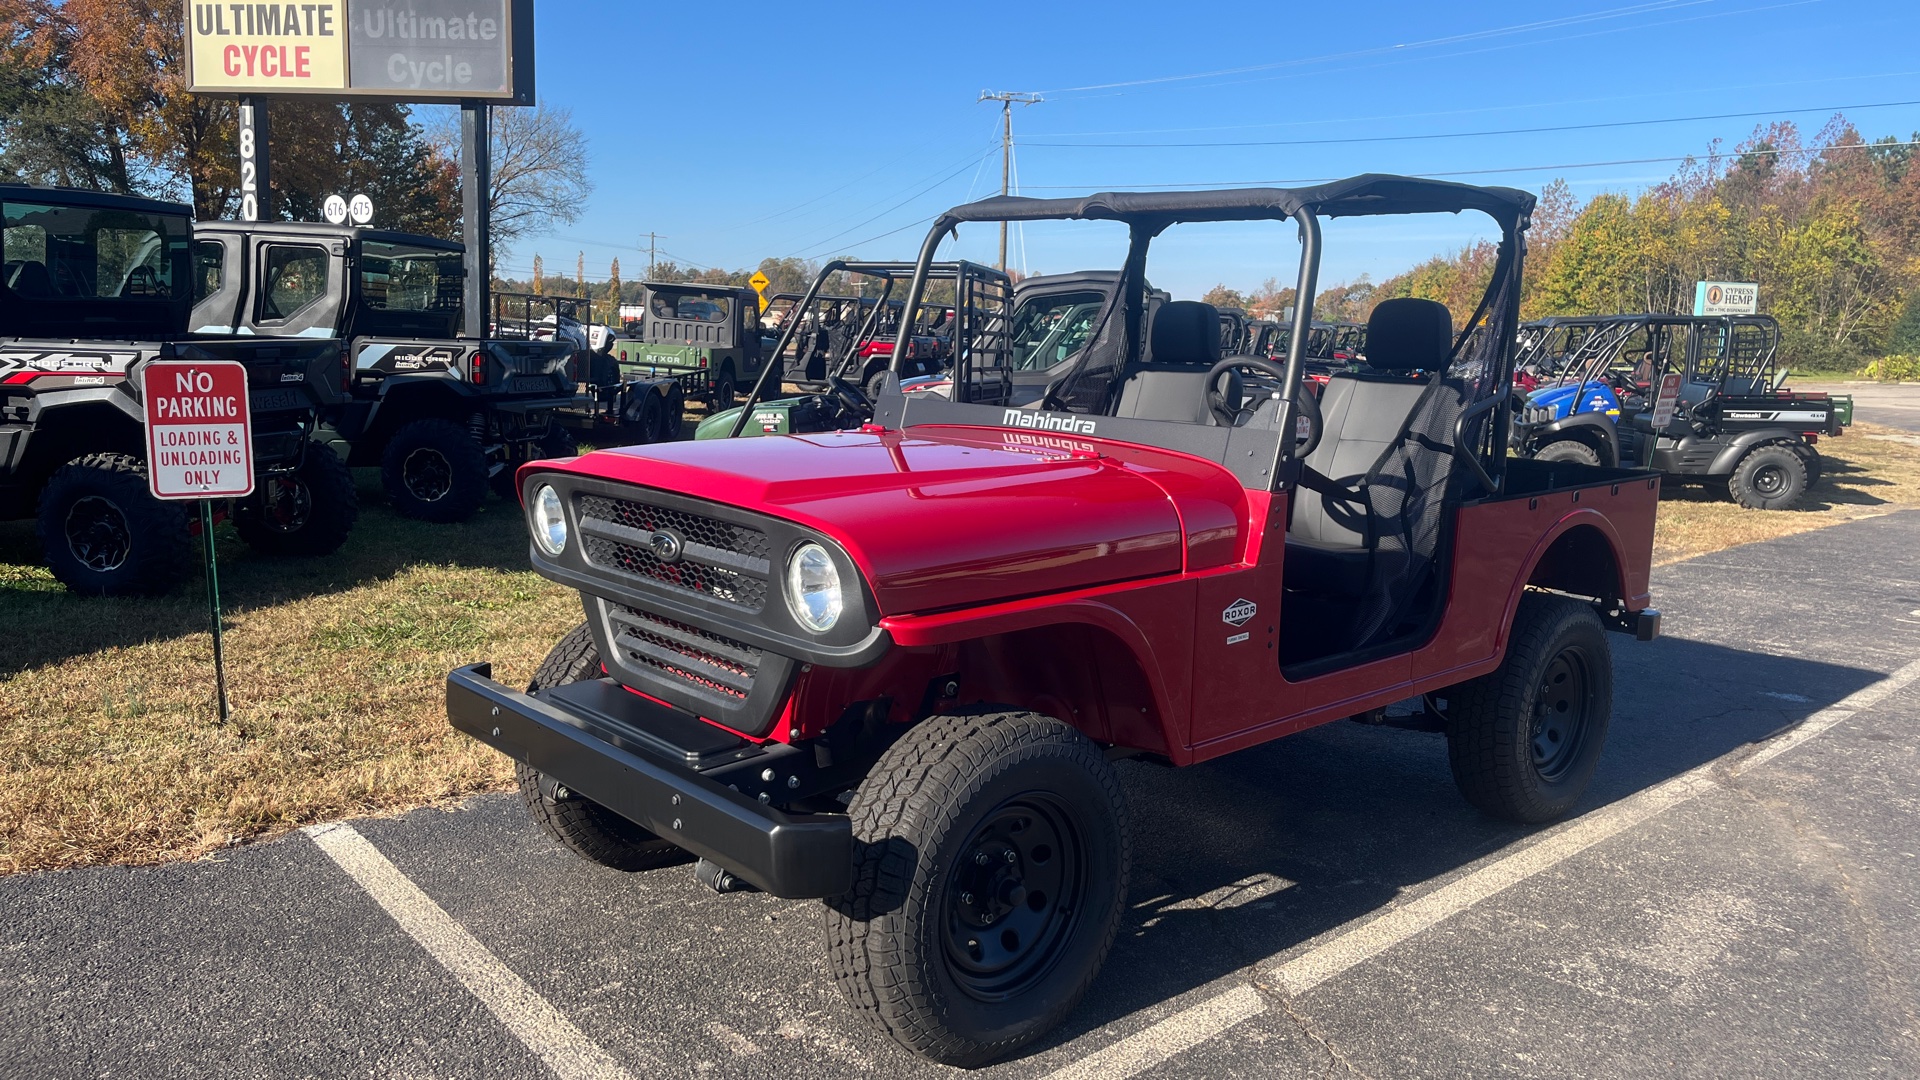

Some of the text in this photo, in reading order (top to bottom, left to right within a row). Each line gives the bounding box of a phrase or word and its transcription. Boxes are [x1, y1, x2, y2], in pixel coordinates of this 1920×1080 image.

[196, 4, 334, 36] ULTIMATE
[363, 7, 498, 40] Ultimate
[223, 45, 311, 77] CYCLE
[387, 52, 472, 88] Cycle
[240, 97, 257, 221] 1820
[327, 202, 344, 216] 676
[353, 201, 370, 215] 675
[1724, 294, 1753, 305] HEMP
[1725, 287, 1754, 295] CYPRESS
[646, 354, 680, 364] ROXOR
[175, 371, 214, 393] NO
[157, 396, 237, 418] PARKING
[252, 391, 297, 409] wasaki
[1002, 409, 1096, 434] Mahindra
[160, 430, 239, 447] LOADING &
[161, 450, 241, 466] UNLOADING
[184, 470, 220, 485] ONLY
[1225, 606, 1255, 620] ROXOR
